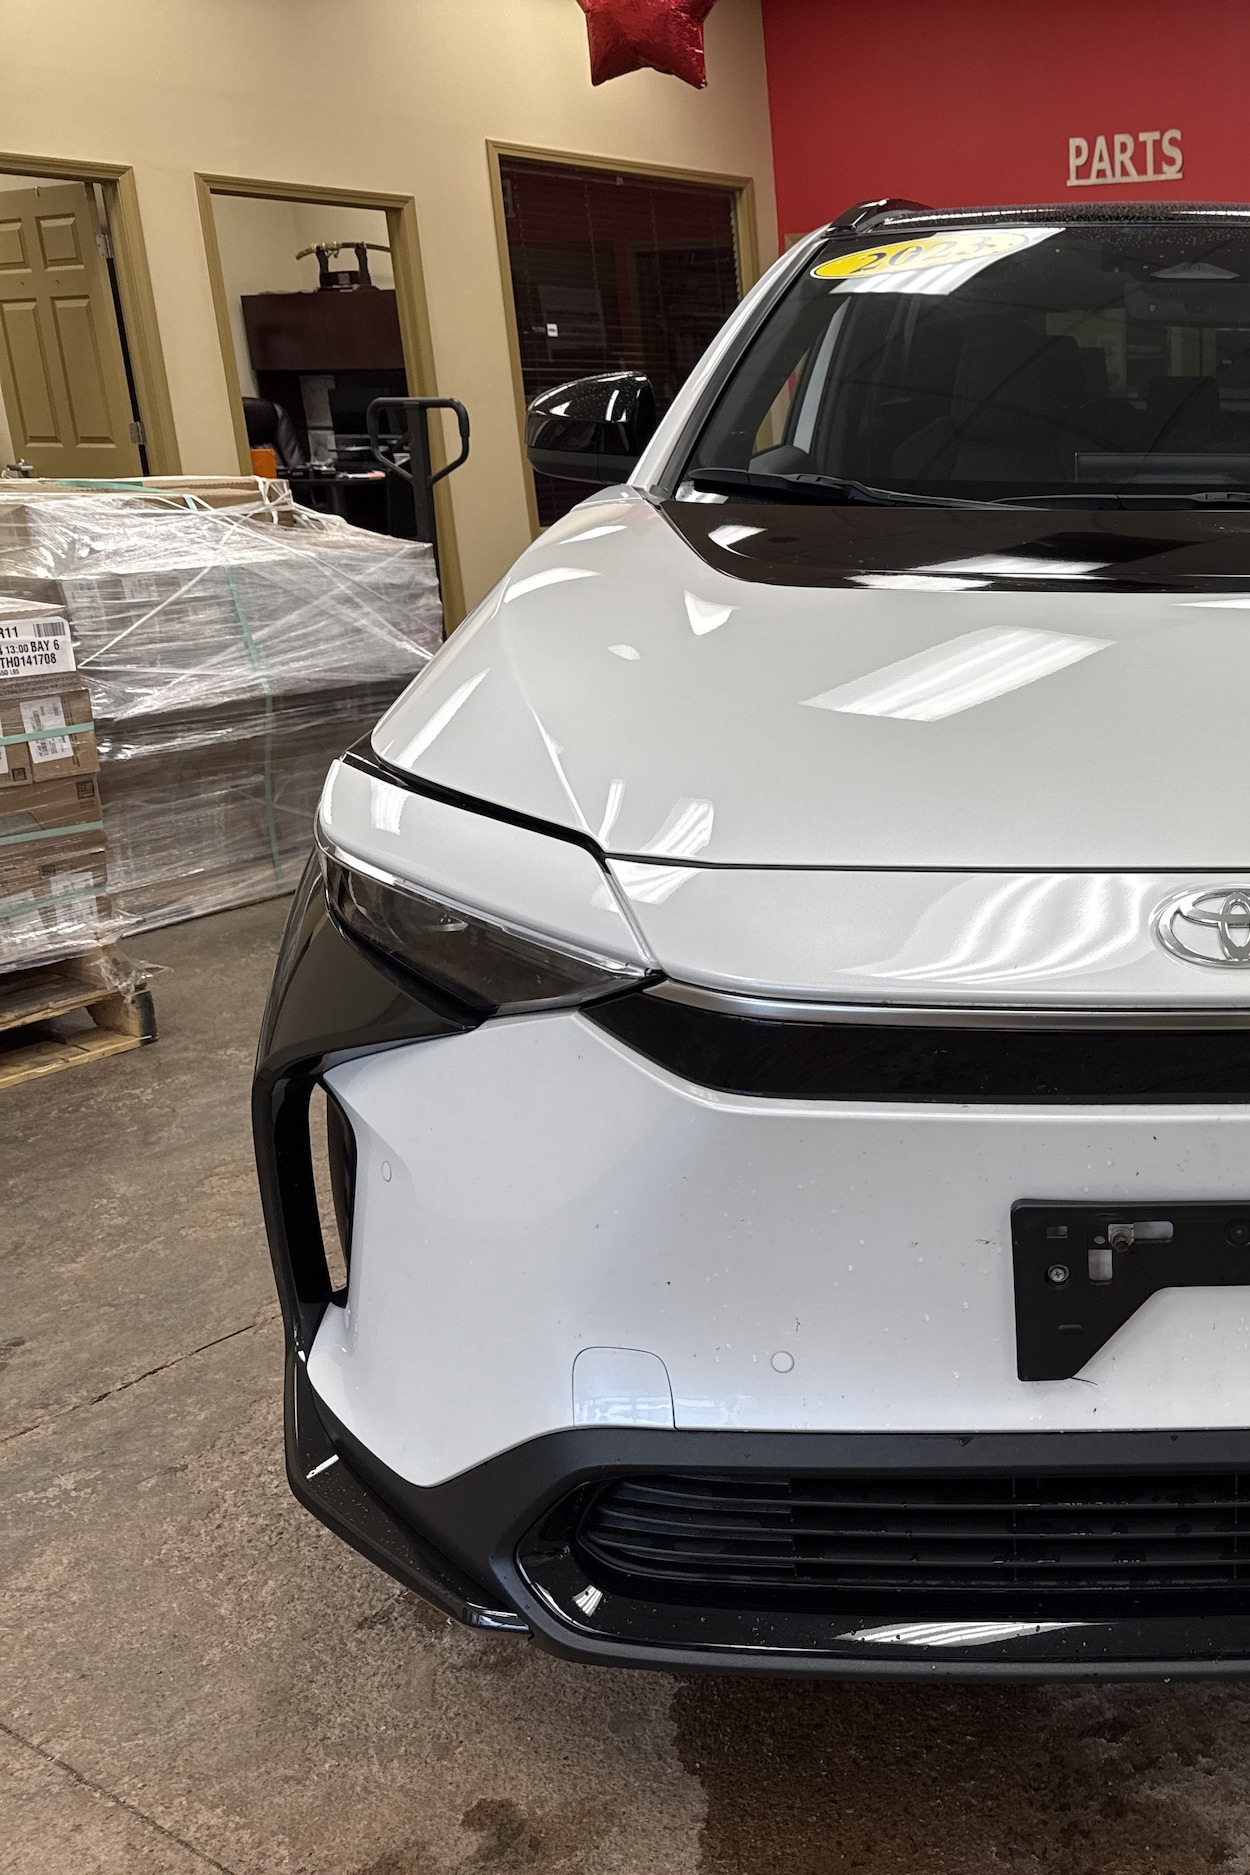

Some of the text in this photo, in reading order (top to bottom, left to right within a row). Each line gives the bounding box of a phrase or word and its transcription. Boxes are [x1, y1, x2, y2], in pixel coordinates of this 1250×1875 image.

[1067, 129, 1183, 184] PARTS
[850, 236, 992, 273] 2023
[5, 644, 29, 654] 13:00
[30, 640, 50, 653] BAY
[53, 639, 60, 651] 6
[0, 653, 57, 669] TH0141708
